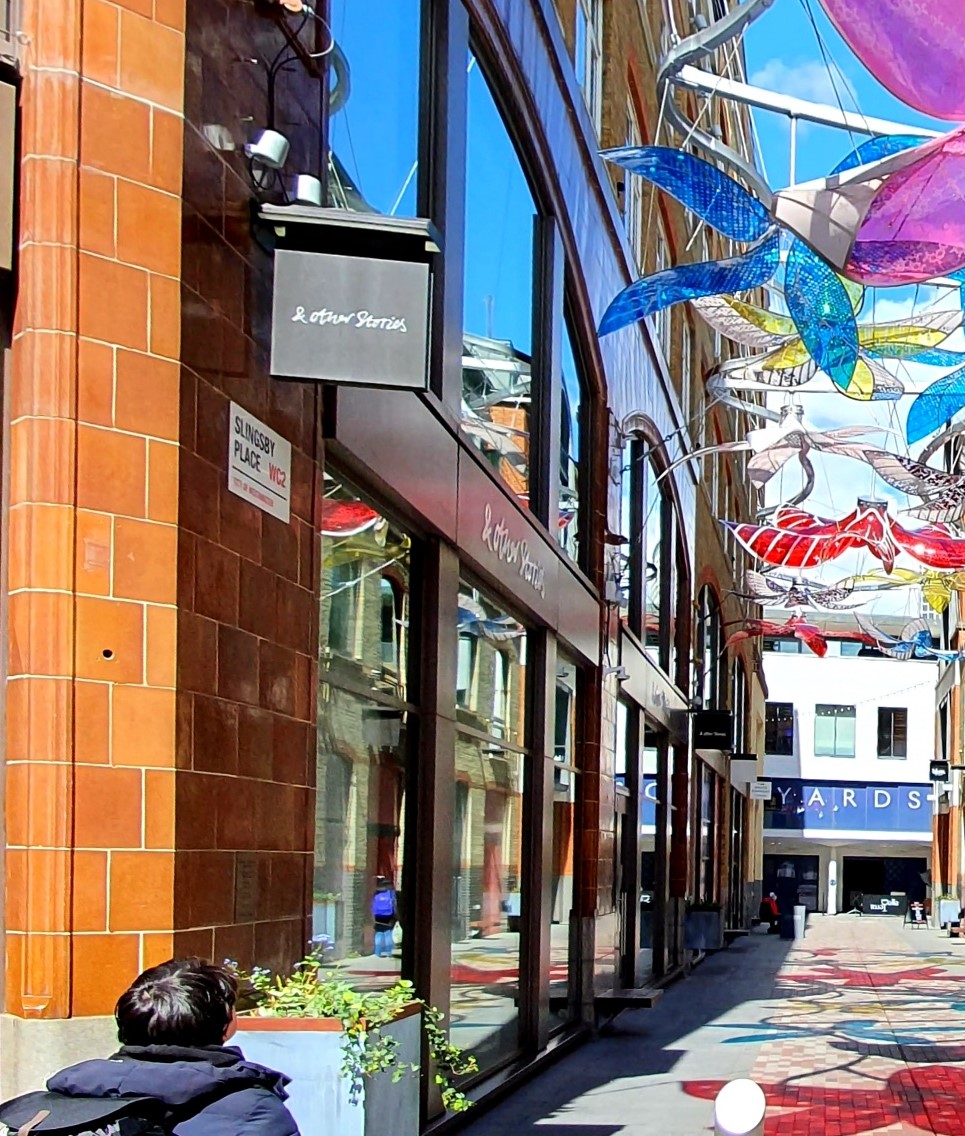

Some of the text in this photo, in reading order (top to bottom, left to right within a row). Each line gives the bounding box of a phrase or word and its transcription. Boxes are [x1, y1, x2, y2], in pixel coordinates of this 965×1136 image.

[291, 306, 407, 333] & other Stories
[234, 415, 275, 457] SLINGSBY
[234, 439, 287, 489] PLACE WC2
[482, 503, 493, 552] &
[777, 786, 922, 809] YARDS
